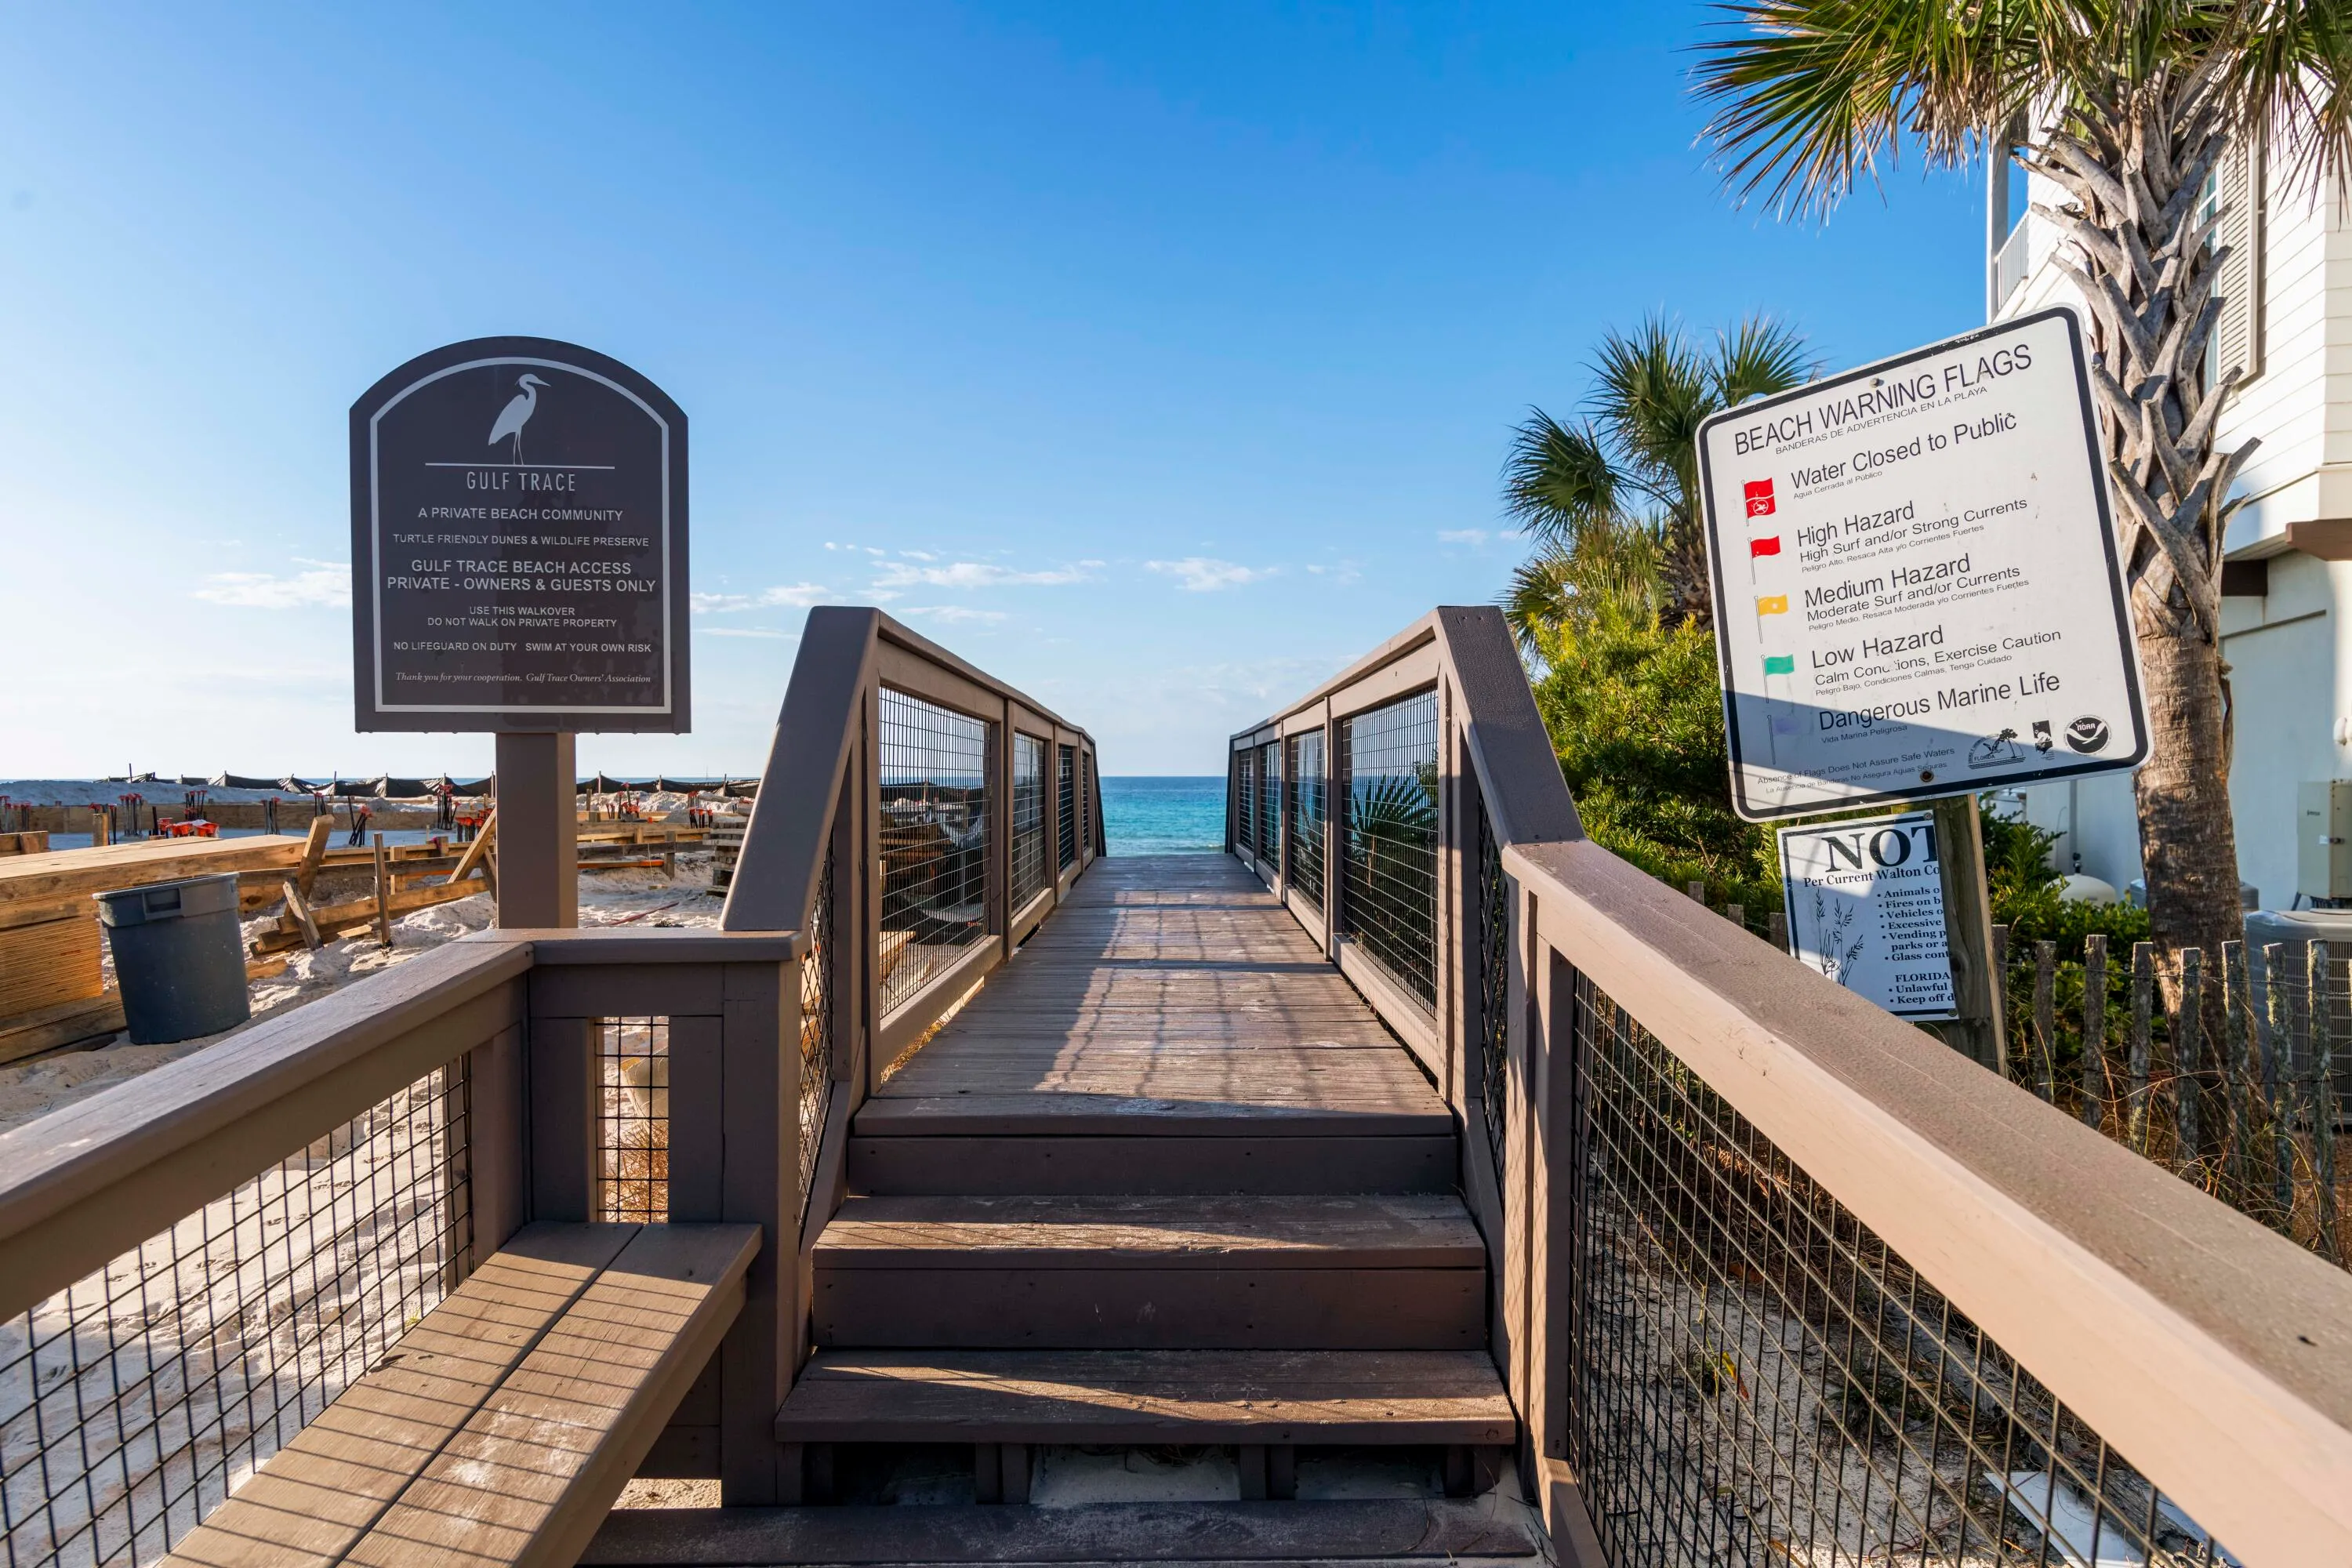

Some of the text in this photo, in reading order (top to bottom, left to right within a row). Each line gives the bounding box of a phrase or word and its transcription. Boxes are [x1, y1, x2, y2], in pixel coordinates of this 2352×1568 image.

[1735, 344, 2031, 456] BEACH WARNING FLAGS
[1775, 386, 1987, 455] BANDERAS DE ADVERTENCIA EN LA PLAYA
[1791, 412, 2016, 489] Water Closed to Public
[466, 471, 575, 491] GULF TRACE
[1793, 490, 1813, 499] Agua
[1814, 481, 1845, 493] Cerrada
[1855, 470, 1882, 482] Público
[418, 507, 623, 521] A PRIVATE BEACH COMMUNITY
[1797, 500, 1915, 547] High Hazard
[1800, 499, 2027, 563] High Surf and/or Strong Currents
[393, 534, 649, 546] TURTLE FRIENDLY DUNES & WILDLIFE PRESERVE
[412, 560, 631, 575] GULF TRACE BEACH ACCESS
[388, 577, 450, 590] PRIVATE
[464, 578, 531, 590] OWNERS
[535, 579, 546, 590] &
[550, 579, 612, 591] GUESTS
[616, 579, 655, 592] ONLY
[1805, 553, 1970, 608] Medium Hazard
[1807, 568, 2020, 622] Moderate Surf and/or Currents
[470, 606, 575, 615] USE THIS WALKOVER
[428, 617, 442, 626] DO
[469, 618, 499, 626] WALK
[501, 618, 516, 626] ON
[519, 618, 560, 626] PRIVATE
[563, 619, 617, 627] PROPERTY
[394, 641, 652, 652] NO LIFEGUARD ON DUTY SWIM AT YOUR OWN RISK
[1812, 624, 1944, 669] Low Hazard
[1815, 672, 1849, 685] Calm
[1934, 644, 1997, 663] Exercise
[2002, 631, 2061, 650] Caution
[395, 672, 423, 681] Thank
[439, 673, 452, 682] for
[474, 673, 522, 683] cooperation.
[526, 673, 546, 684] Gulf
[546, 673, 568, 682] Trace
[569, 673, 604, 682] Owners'
[604, 674, 651, 683] Association
[1816, 687, 1841, 696] Peligro
[1864, 673, 1912, 688] Condiciones
[1950, 662, 1975, 671] Tenga
[1976, 655, 2013, 666] Cuidado
[1820, 672, 2060, 730] Dangerous Marine Life
[1841, 731, 1868, 741] Marina
[1869, 725, 1907, 736] Peligrosa
[1756, 746, 1955, 785] Absence of Flags Does Not Assure Safe Waters
[1804, 877, 1824, 887] Per
[1827, 872, 1874, 885] Current
[1876, 869, 1921, 880] Walton
[1884, 887, 1930, 898] Animals
[1886, 899, 1914, 908] Fires
[1886, 908, 1933, 919] Vehicles
[1888, 919, 1941, 929] Excessive
[1889, 930, 1936, 940] Vending
[1891, 941, 1923, 953] parks
[1892, 953, 1922, 961] Glass
[1895, 971, 1951, 982] FLORIDA
[1896, 982, 1948, 993] Unlawful
[1897, 996, 1926, 1004] Keep
[1929, 993, 1945, 1002] off
